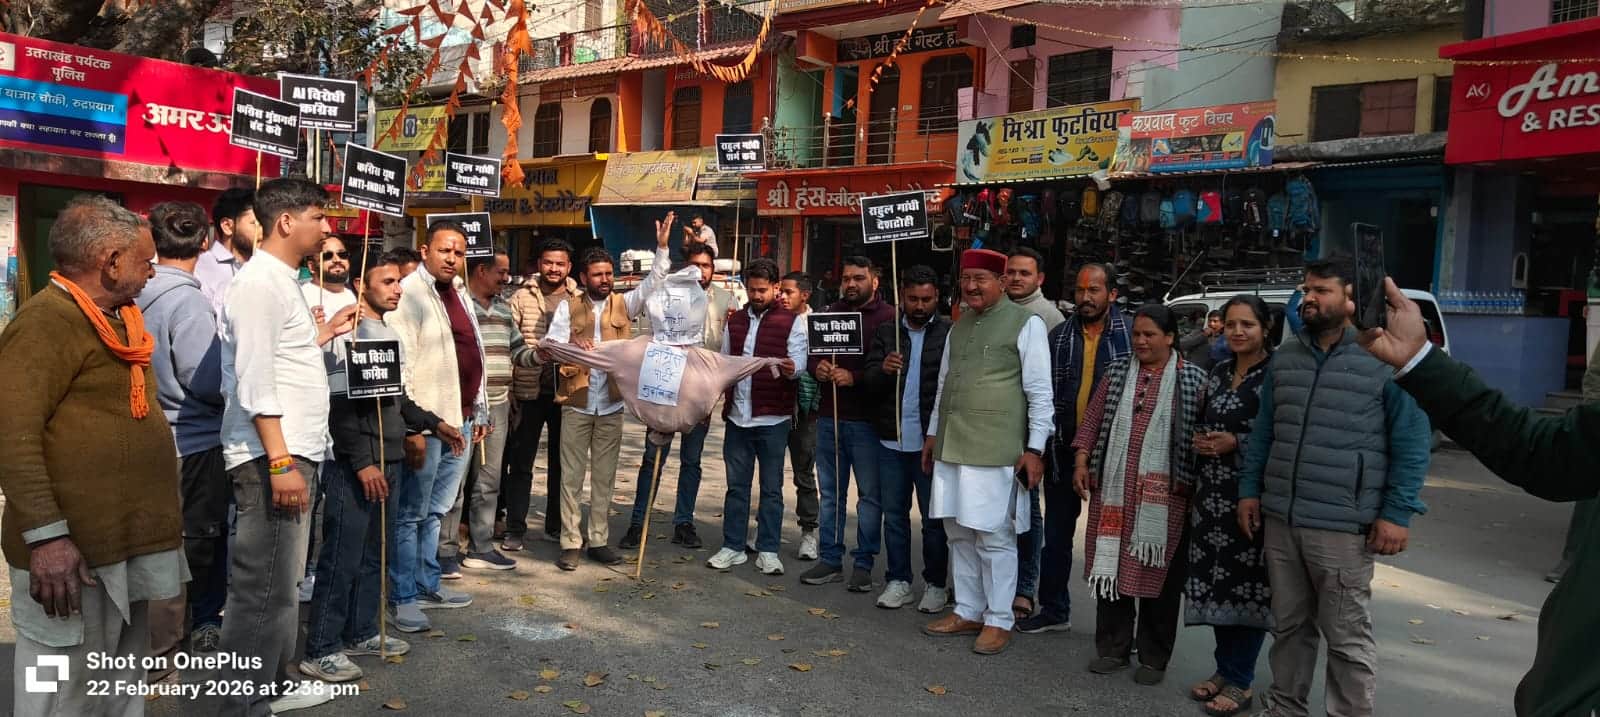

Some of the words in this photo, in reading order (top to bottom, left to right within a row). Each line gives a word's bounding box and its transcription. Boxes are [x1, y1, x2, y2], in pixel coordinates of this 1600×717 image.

[873, 34, 890, 54] श्री
[915, 30, 944, 48] गेस्ट
[25, 46, 73, 63] उत्तराखंड
[75, 55, 113, 70] पर्यटक
[51, 66, 86, 82] पुलिस
[142, 102, 205, 131] अमर
[1521, 112, 1543, 132] &
[1547, 104, 1600, 130] RES
[1002, 117, 1048, 142] मिश्रा
[348, 176, 386, 194] ANTI-INDIA
[767, 181, 790, 208] श्री
[795, 181, 827, 210] हंस
[868, 204, 894, 218] राहुल
[896, 199, 920, 212] गांधी
[813, 320, 829, 331] देश
[830, 319, 857, 331] विरोधी
[351, 350, 367, 364] देश
[368, 349, 395, 364] विरोधी
